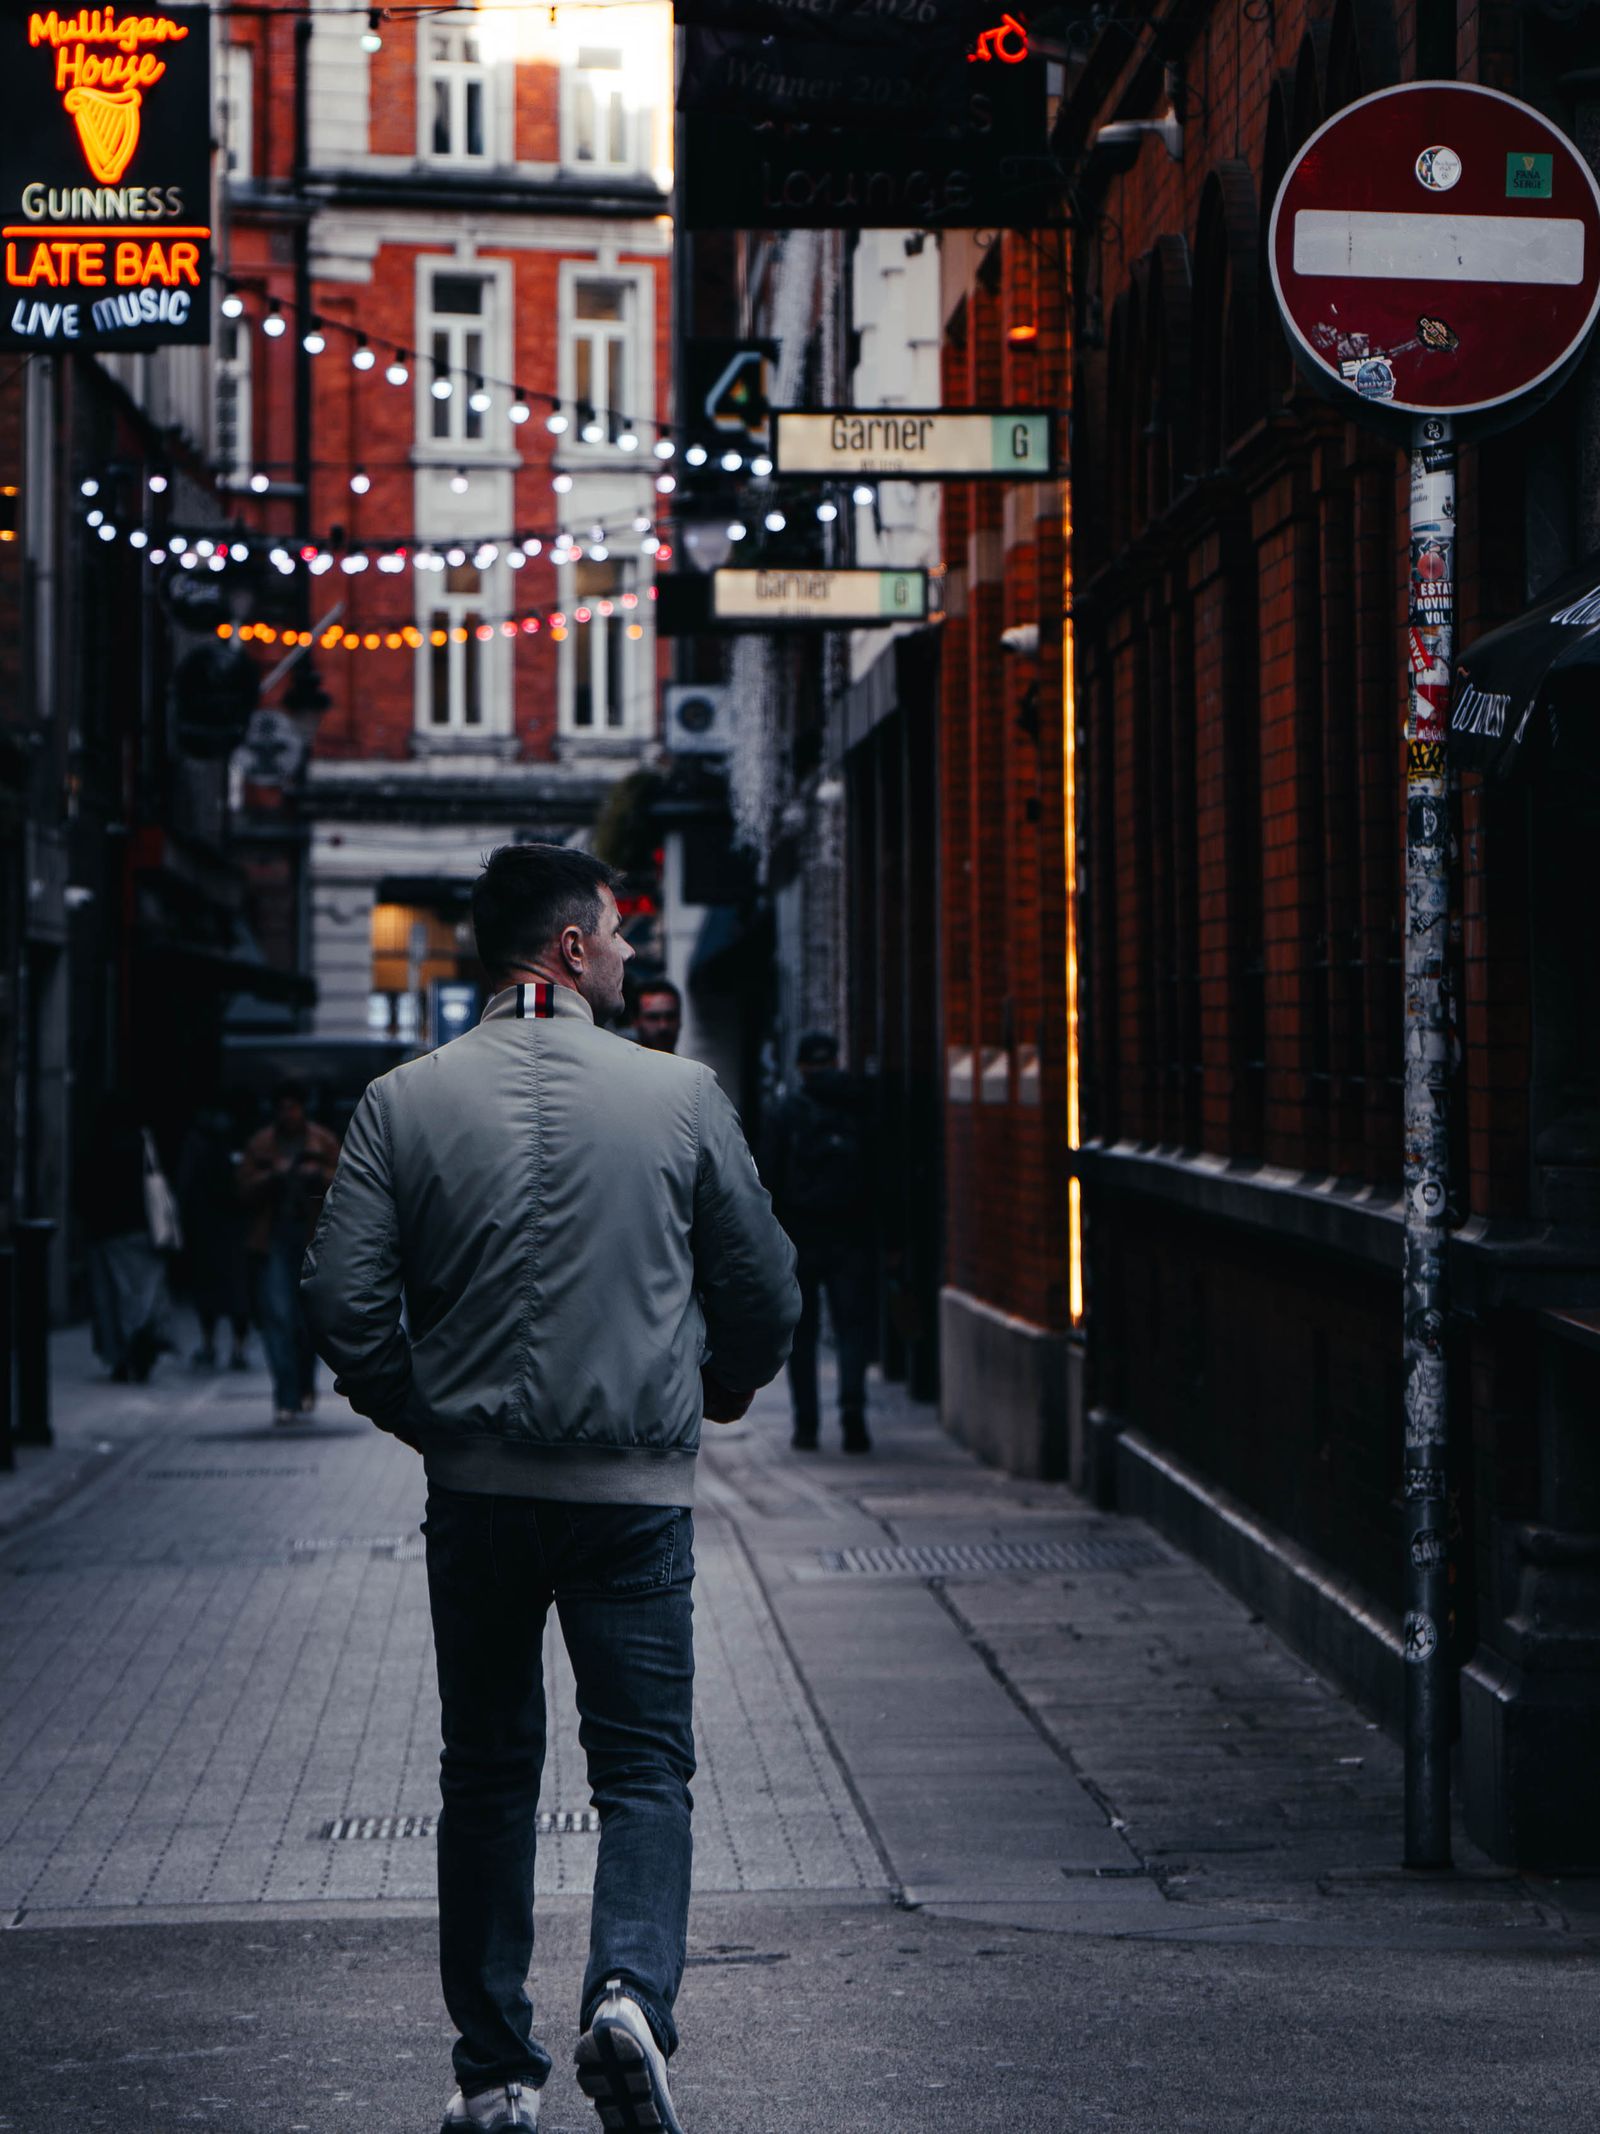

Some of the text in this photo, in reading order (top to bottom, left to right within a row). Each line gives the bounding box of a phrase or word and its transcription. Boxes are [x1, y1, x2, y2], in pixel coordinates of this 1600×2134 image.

[29, 6, 189, 52] Mulligan
[56, 43, 166, 91] House
[726, 55, 842, 100] Winner
[21, 182, 185, 221] GUINNESS
[5, 241, 200, 287] LATE BAR
[11, 287, 191, 338] LIVE MUSIC
[832, 413, 1028, 460] Garner G
